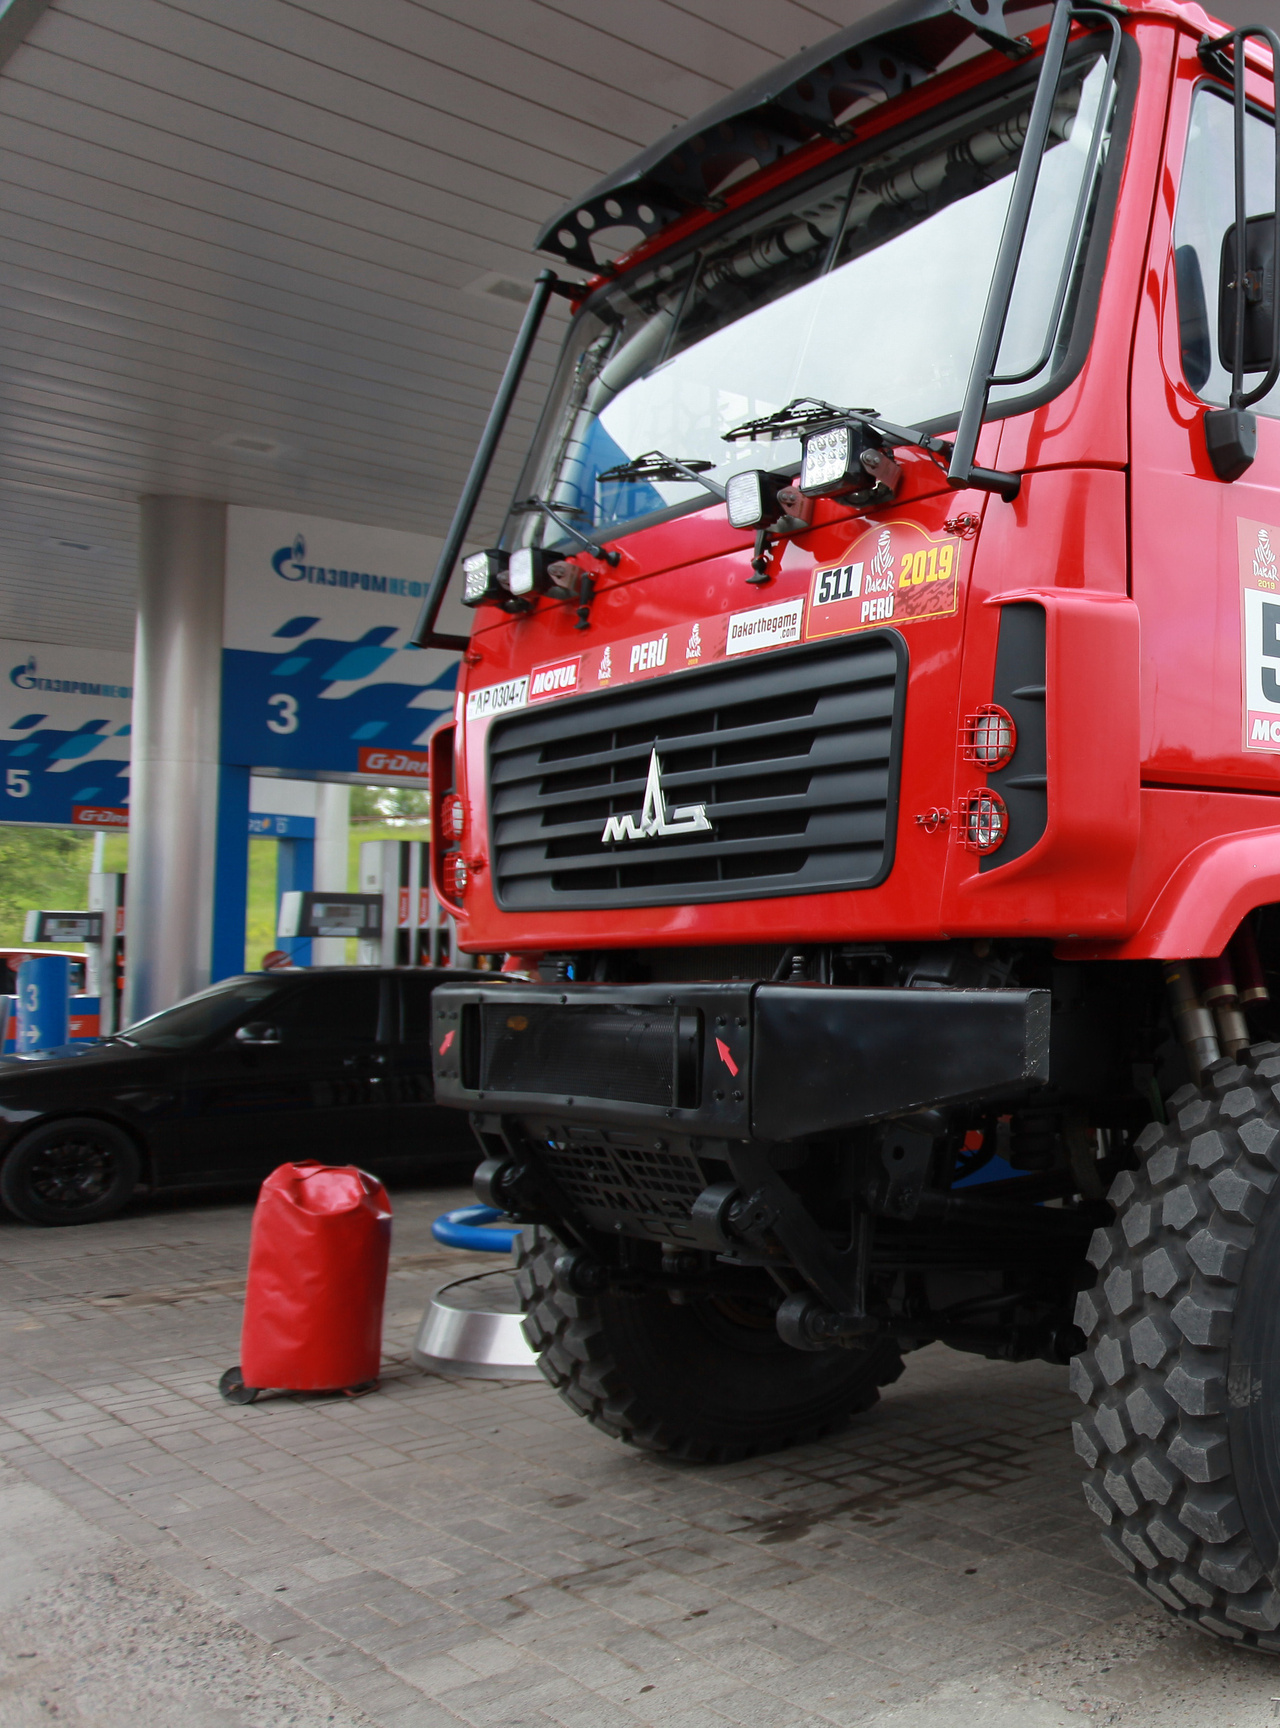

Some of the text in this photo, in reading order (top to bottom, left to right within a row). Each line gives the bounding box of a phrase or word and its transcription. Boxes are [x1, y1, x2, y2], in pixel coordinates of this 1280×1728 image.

[306, 565, 431, 598] ГАЗПРОМНЕФТ
[899, 544, 954, 588] 2019
[1253, 560, 1280, 582] DAKAR
[819, 565, 853, 603] 511
[865, 570, 895, 595] DAKAR
[1257, 579, 1276, 590] 2019
[860, 592, 895, 623] PERÚ
[731, 612, 797, 639] Dakarthegame
[780, 627, 796, 639] .com
[629, 632, 669, 673] PERÚ
[531, 664, 577, 695] MOTUL
[475, 680, 526, 714] AP 0304-7
[266, 692, 299, 735] 3
[5, 768, 31, 798] 5
[26, 984, 40, 1012] 3
